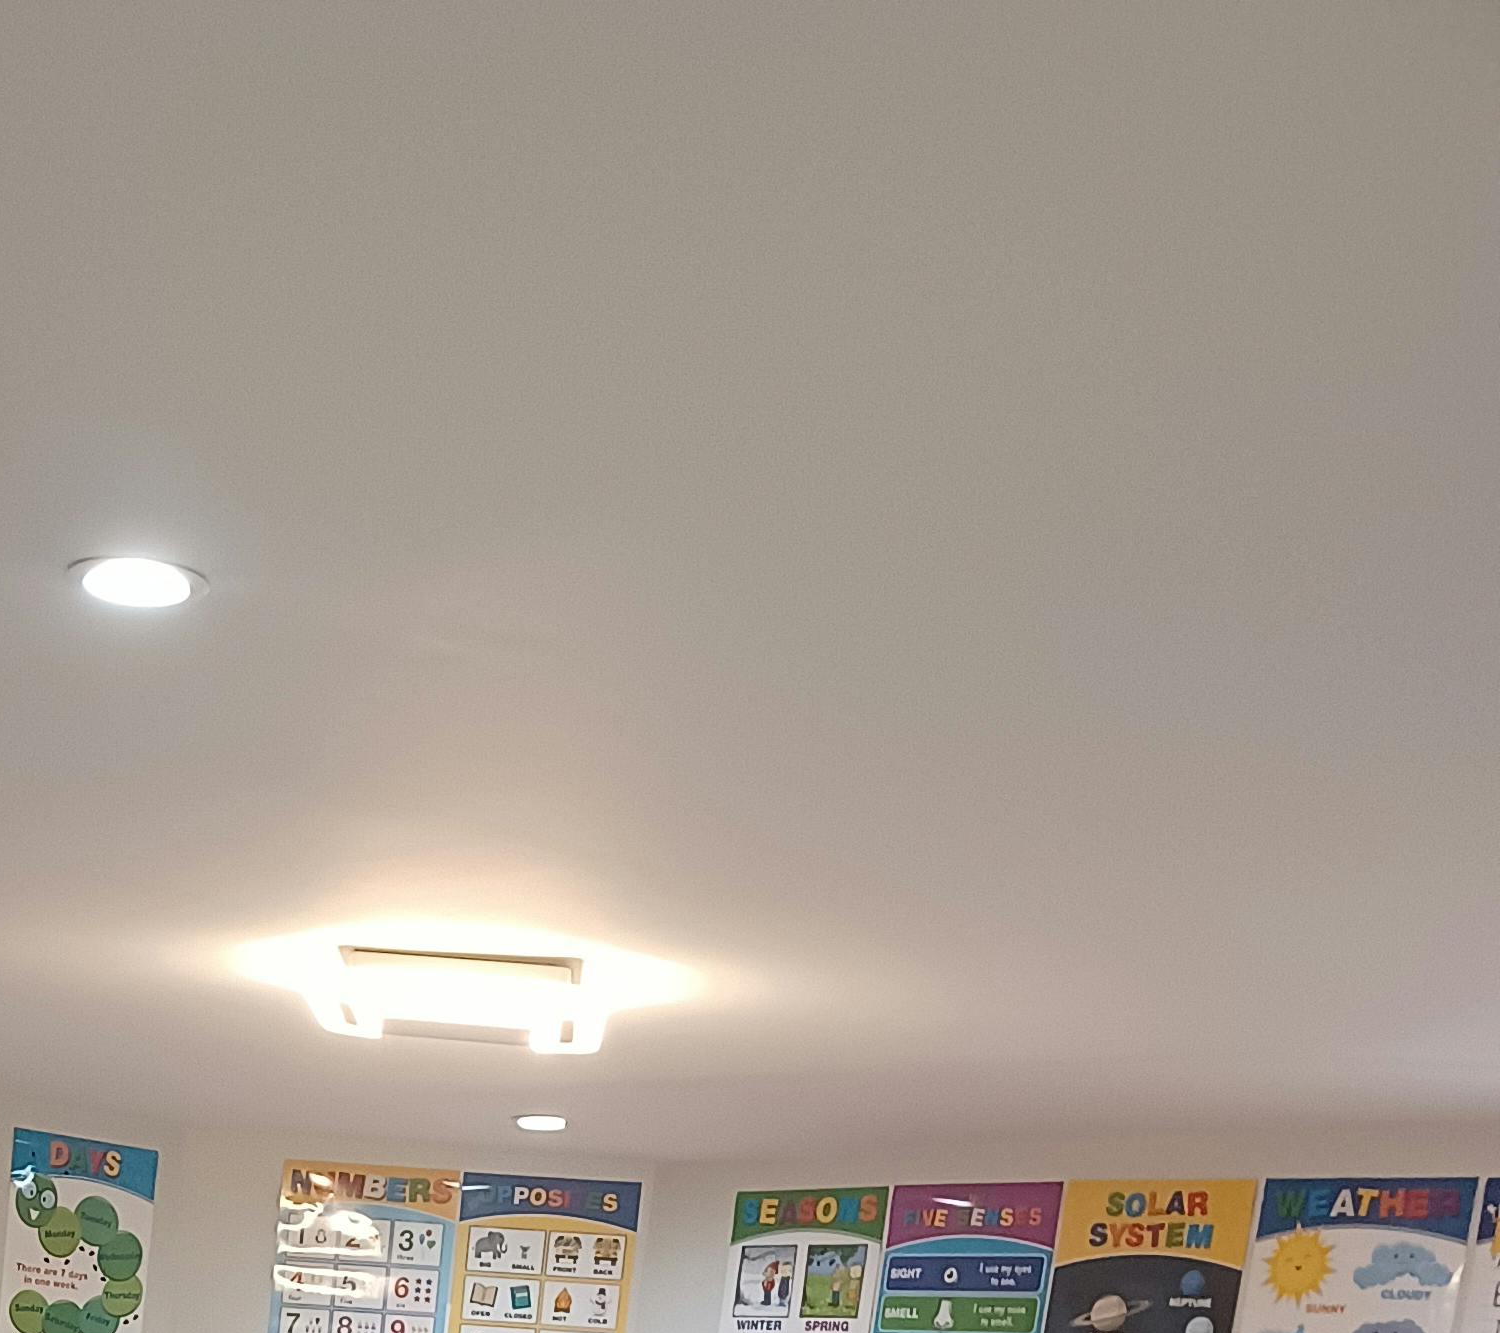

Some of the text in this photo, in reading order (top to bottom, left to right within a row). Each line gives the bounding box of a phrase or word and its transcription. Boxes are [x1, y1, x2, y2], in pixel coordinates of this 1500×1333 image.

[50, 1140, 122, 1178] DAYS
[743, 1195, 878, 1226] SEASONS
[1106, 1190, 1209, 1217] SOLAR
[904, 1208, 949, 1227] FIVE
[399, 1230, 414, 1251] 3
[1089, 1222, 1214, 1248] SYSTEM
[16, 1263, 41, 1274] There
[68, 1271, 88, 1280] days
[891, 1268, 922, 1279] SIGHT
[394, 1277, 410, 1298] 6
[1381, 1290, 1431, 1300] CLOUDY
[884, 1307, 918, 1319] SMELL
[1306, 1304, 1346, 1313] SUNNY
[286, 1312, 300, 1333] 7
[737, 1320, 782, 1331] WINTER
[805, 1320, 849, 1331] SPRING
